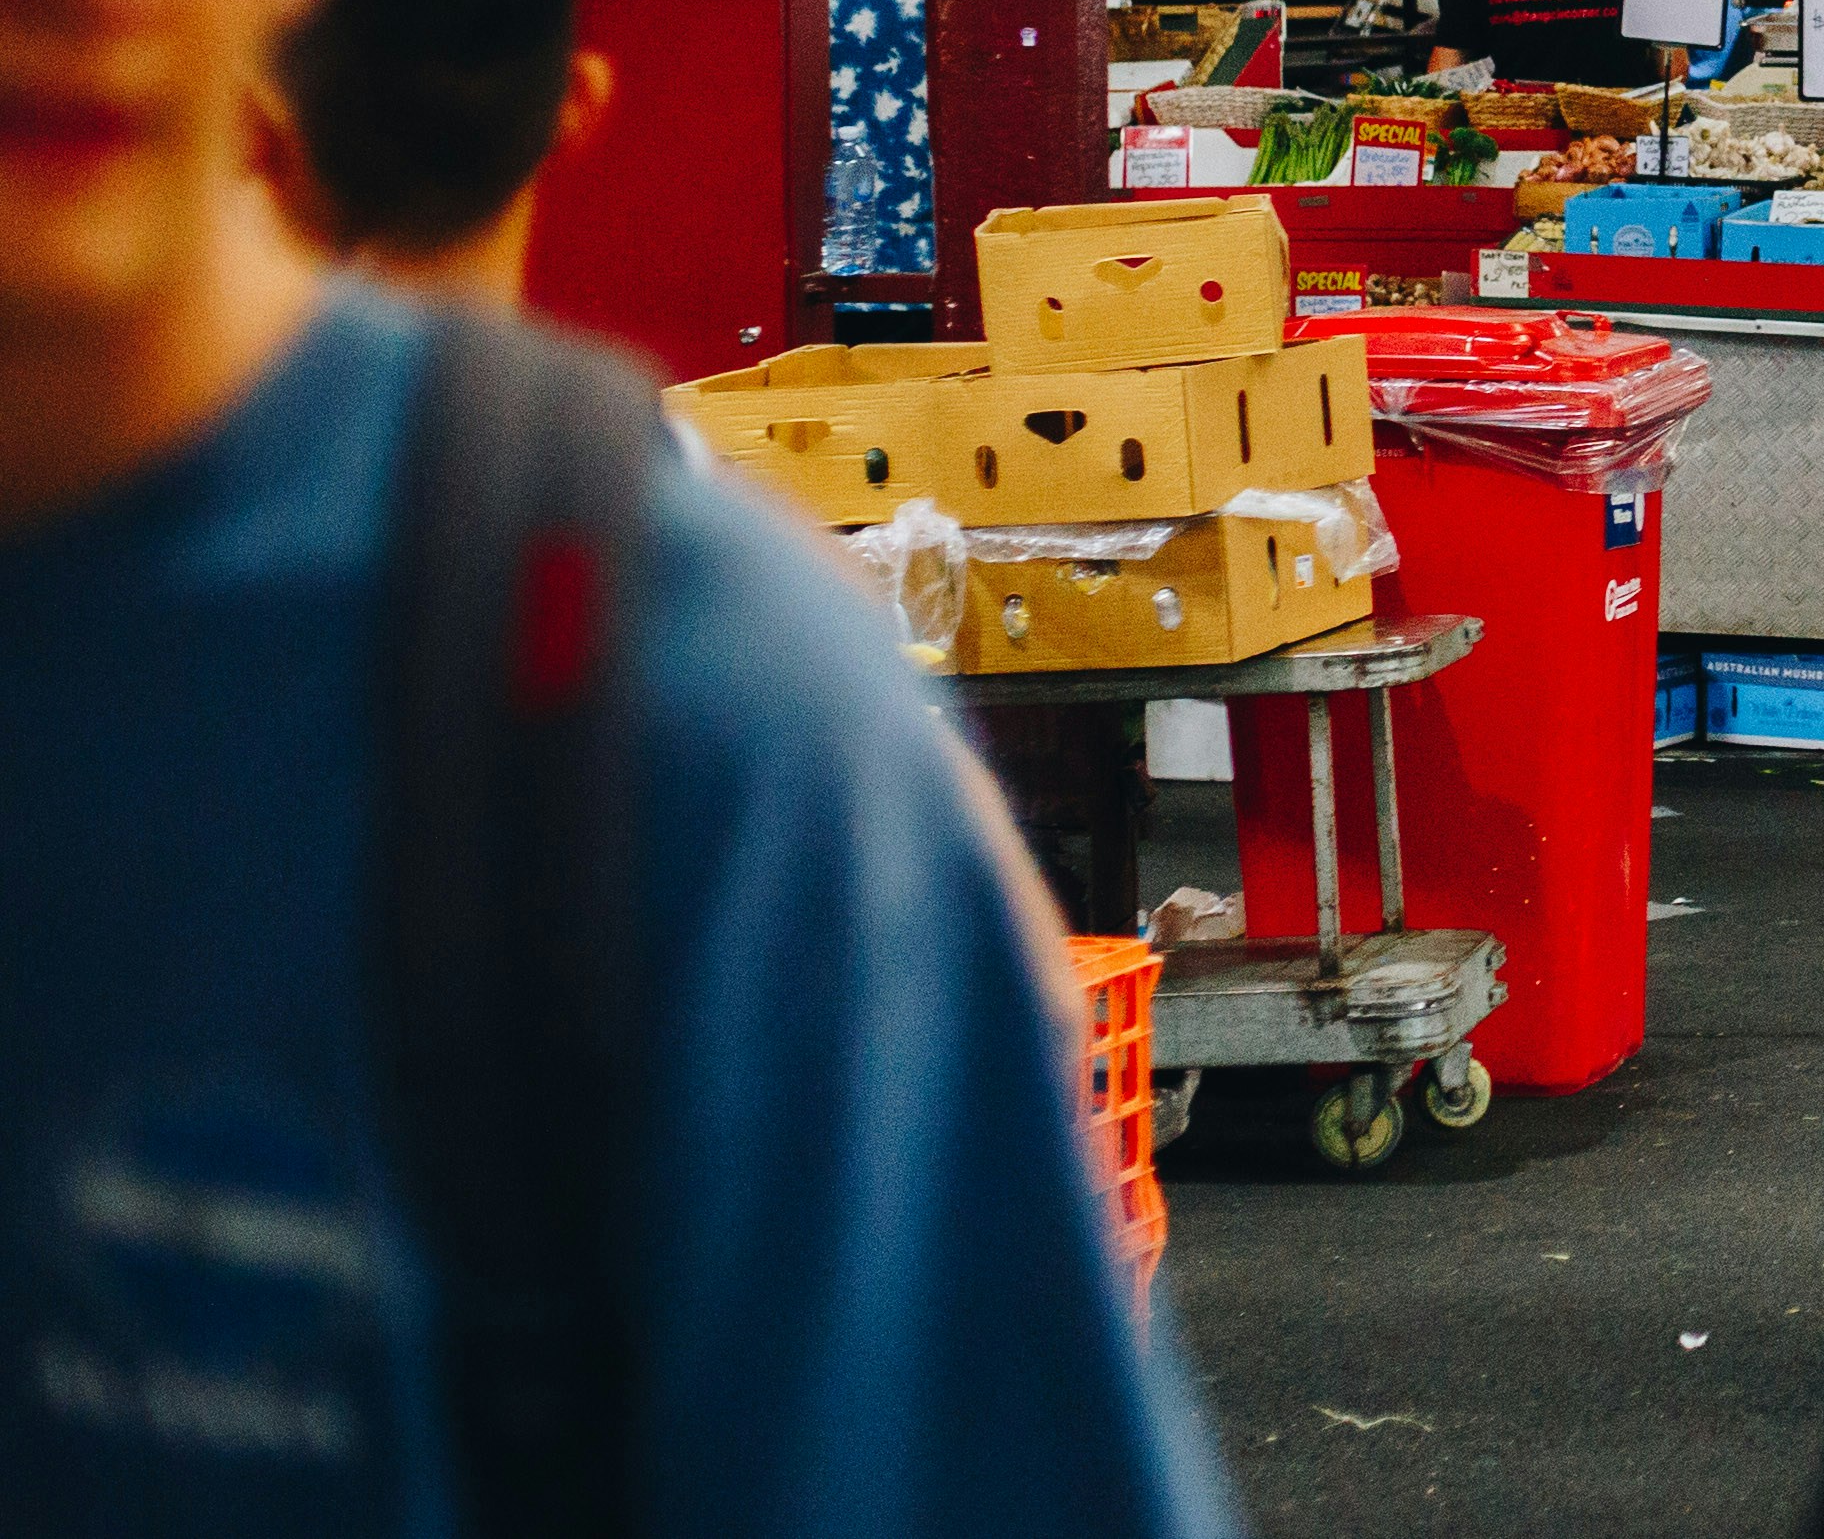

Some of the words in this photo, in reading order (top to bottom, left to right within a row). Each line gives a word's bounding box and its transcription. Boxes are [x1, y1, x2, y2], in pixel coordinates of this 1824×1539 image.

[1357, 121, 1422, 146] SPECIAL
[1296, 270, 1363, 291] SPECIAL
[1706, 661, 1780, 677] AUSTRALIAN
